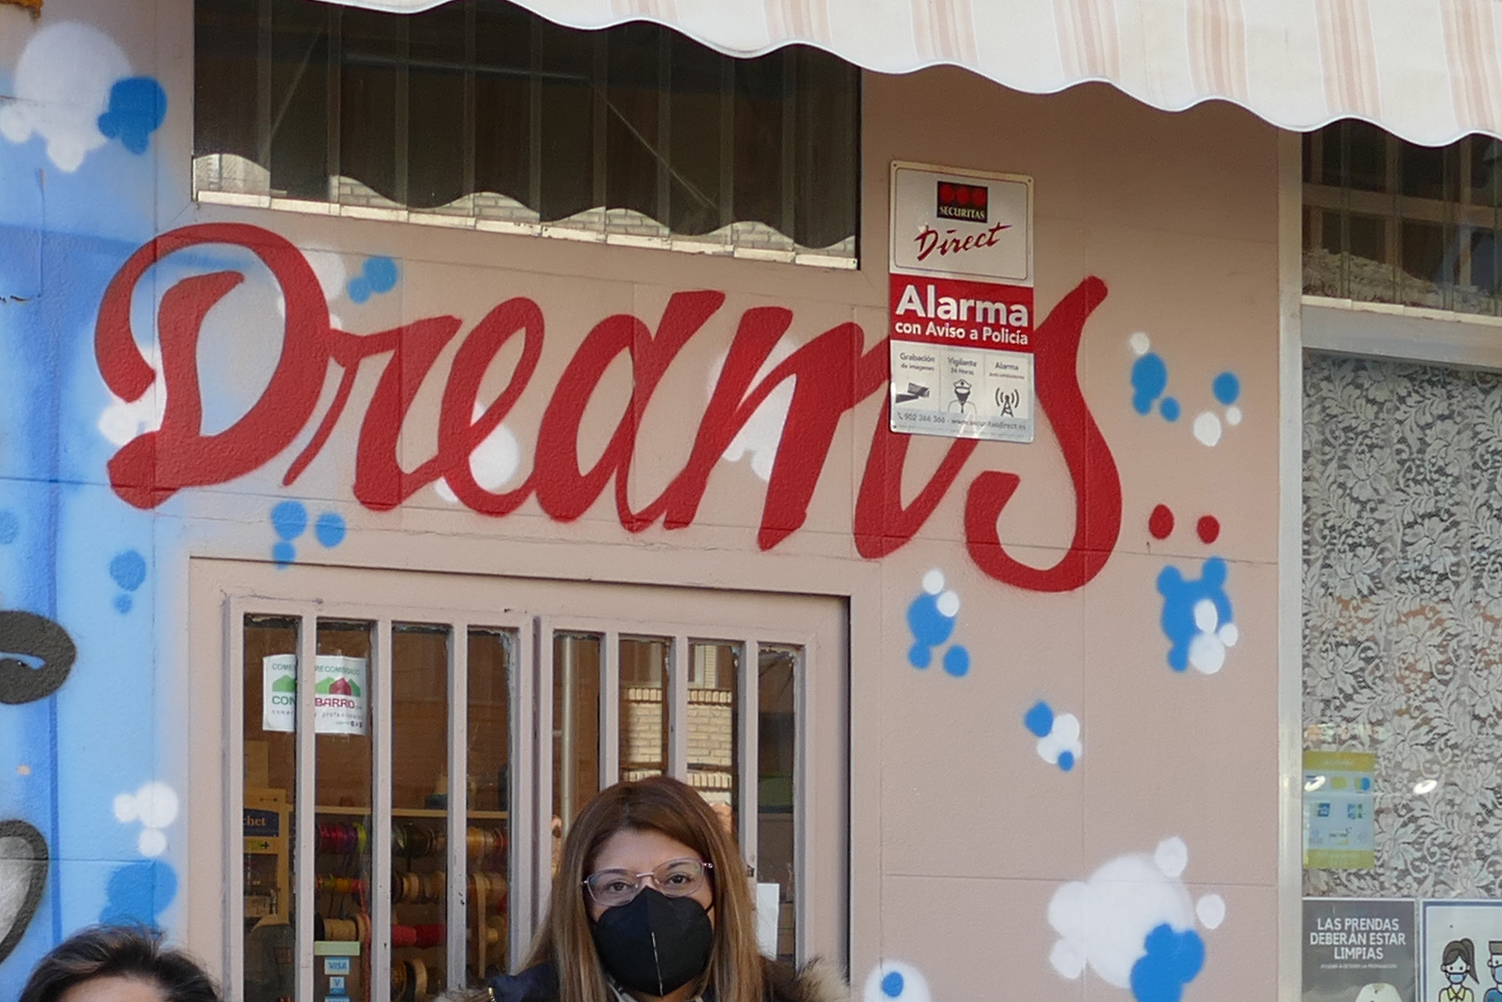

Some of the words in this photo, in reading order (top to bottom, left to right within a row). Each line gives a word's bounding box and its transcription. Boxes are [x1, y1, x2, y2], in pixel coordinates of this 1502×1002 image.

[939, 206, 986, 219] SECURITAS
[914, 222, 1013, 261] Direct
[895, 284, 1029, 328] Alarma
[895, 322, 922, 335] con
[925, 321, 966, 339] Aviso
[969, 328, 979, 341] a
[982, 326, 1029, 345] Policía
[1317, 918, 1342, 931] LAS
[1344, 918, 1400, 931] PRENDAS
[1369, 932, 1407, 945] ESTAR
[1334, 946, 1384, 960] LIMPIAS
[328, 961, 347, 970] VISA
